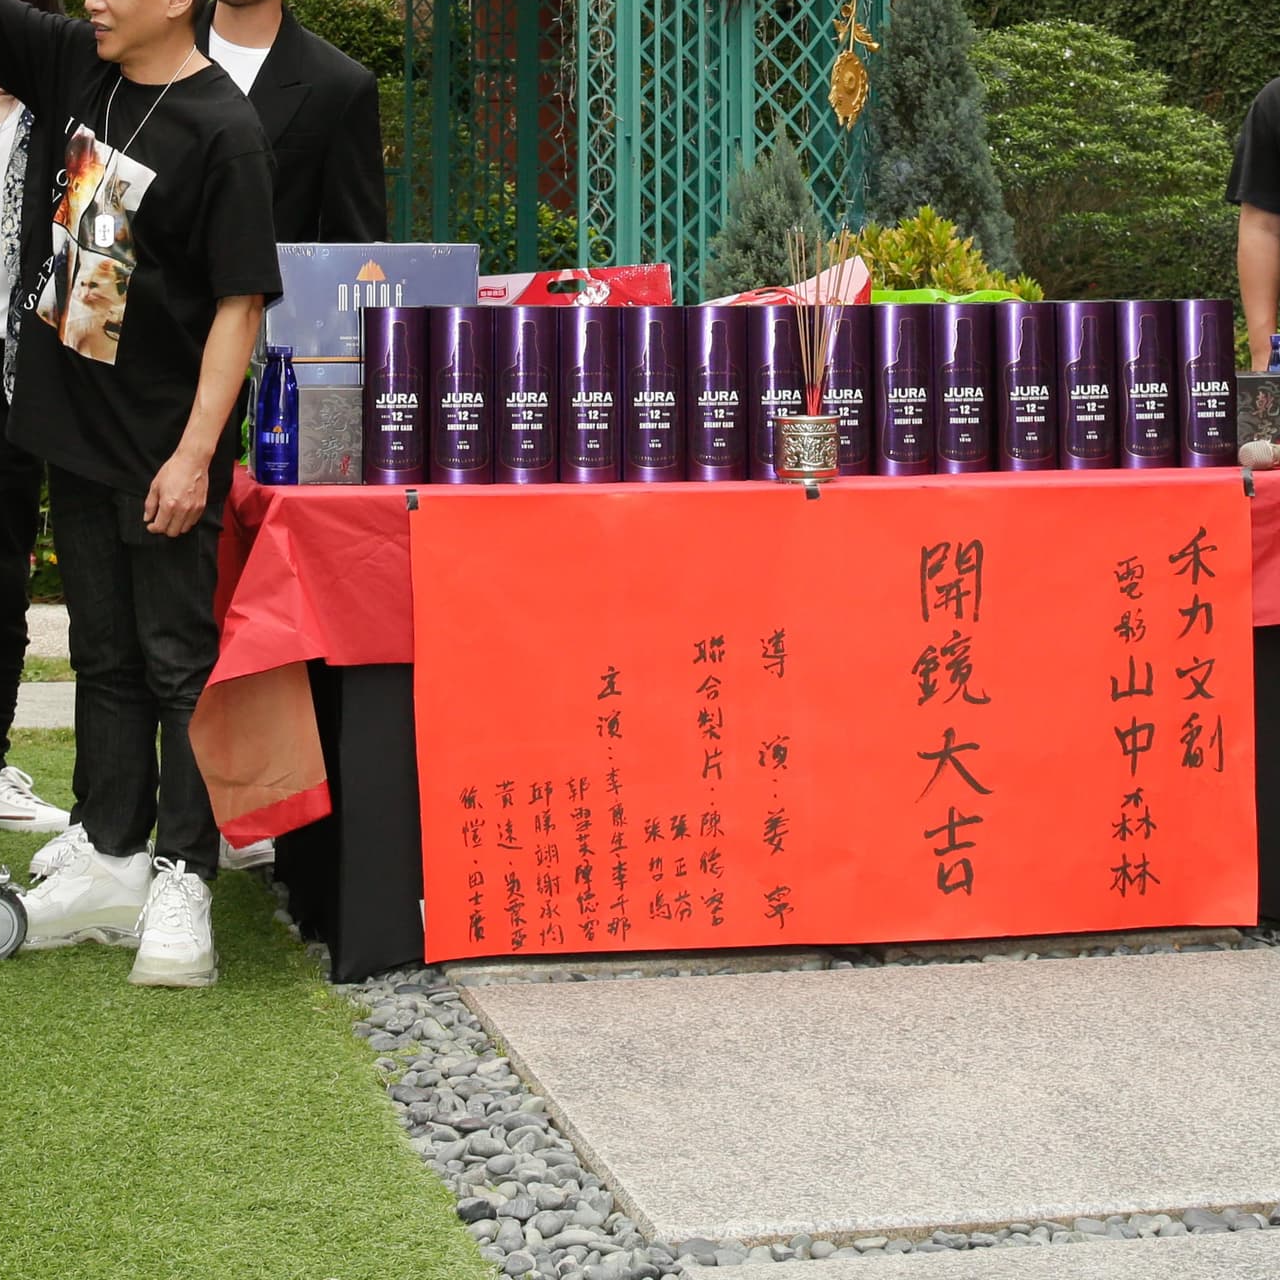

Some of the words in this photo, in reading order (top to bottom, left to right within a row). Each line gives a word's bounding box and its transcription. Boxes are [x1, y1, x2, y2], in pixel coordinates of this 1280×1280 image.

[944, 387, 983, 397] JURA
[1010, 386, 1048, 396] JURA
[1071, 385, 1109, 395] JURA
[1130, 383, 1168, 393] JURA
[1192, 382, 1229, 392] JURA
[442, 393, 483, 403] JURA
[507, 392, 547, 403] JURA
[572, 392, 612, 402] JURA
[634, 392, 674, 402] JURA
[698, 391, 738, 401] JURA
[762, 390, 801, 400] JURA
[824, 389, 862, 399] JURA
[888, 388, 926, 398] JURA
[376, 394, 418, 404] JURA
[1207, 399, 1217, 408] 12
[904, 406, 914, 415] 12
[960, 405, 970, 414] 12
[1026, 404, 1036, 413] 12
[1087, 402, 1096, 411] 12
[1146, 401, 1156, 410] 12
[392, 412, 402, 421] 12
[458, 411, 468, 420] 12
[522, 411, 533, 420] 12
[588, 410, 598, 419] 12
[650, 410, 660, 419] 12
[714, 409, 724, 418] 12
[778, 408, 787, 416] 12
[839, 407, 849, 416] 12
[1169, 527, 1224, 772] 禾力文創
[912, 540, 992, 895] 開鏡大吉
[1111, 556, 1160, 897] 電影山中森林
